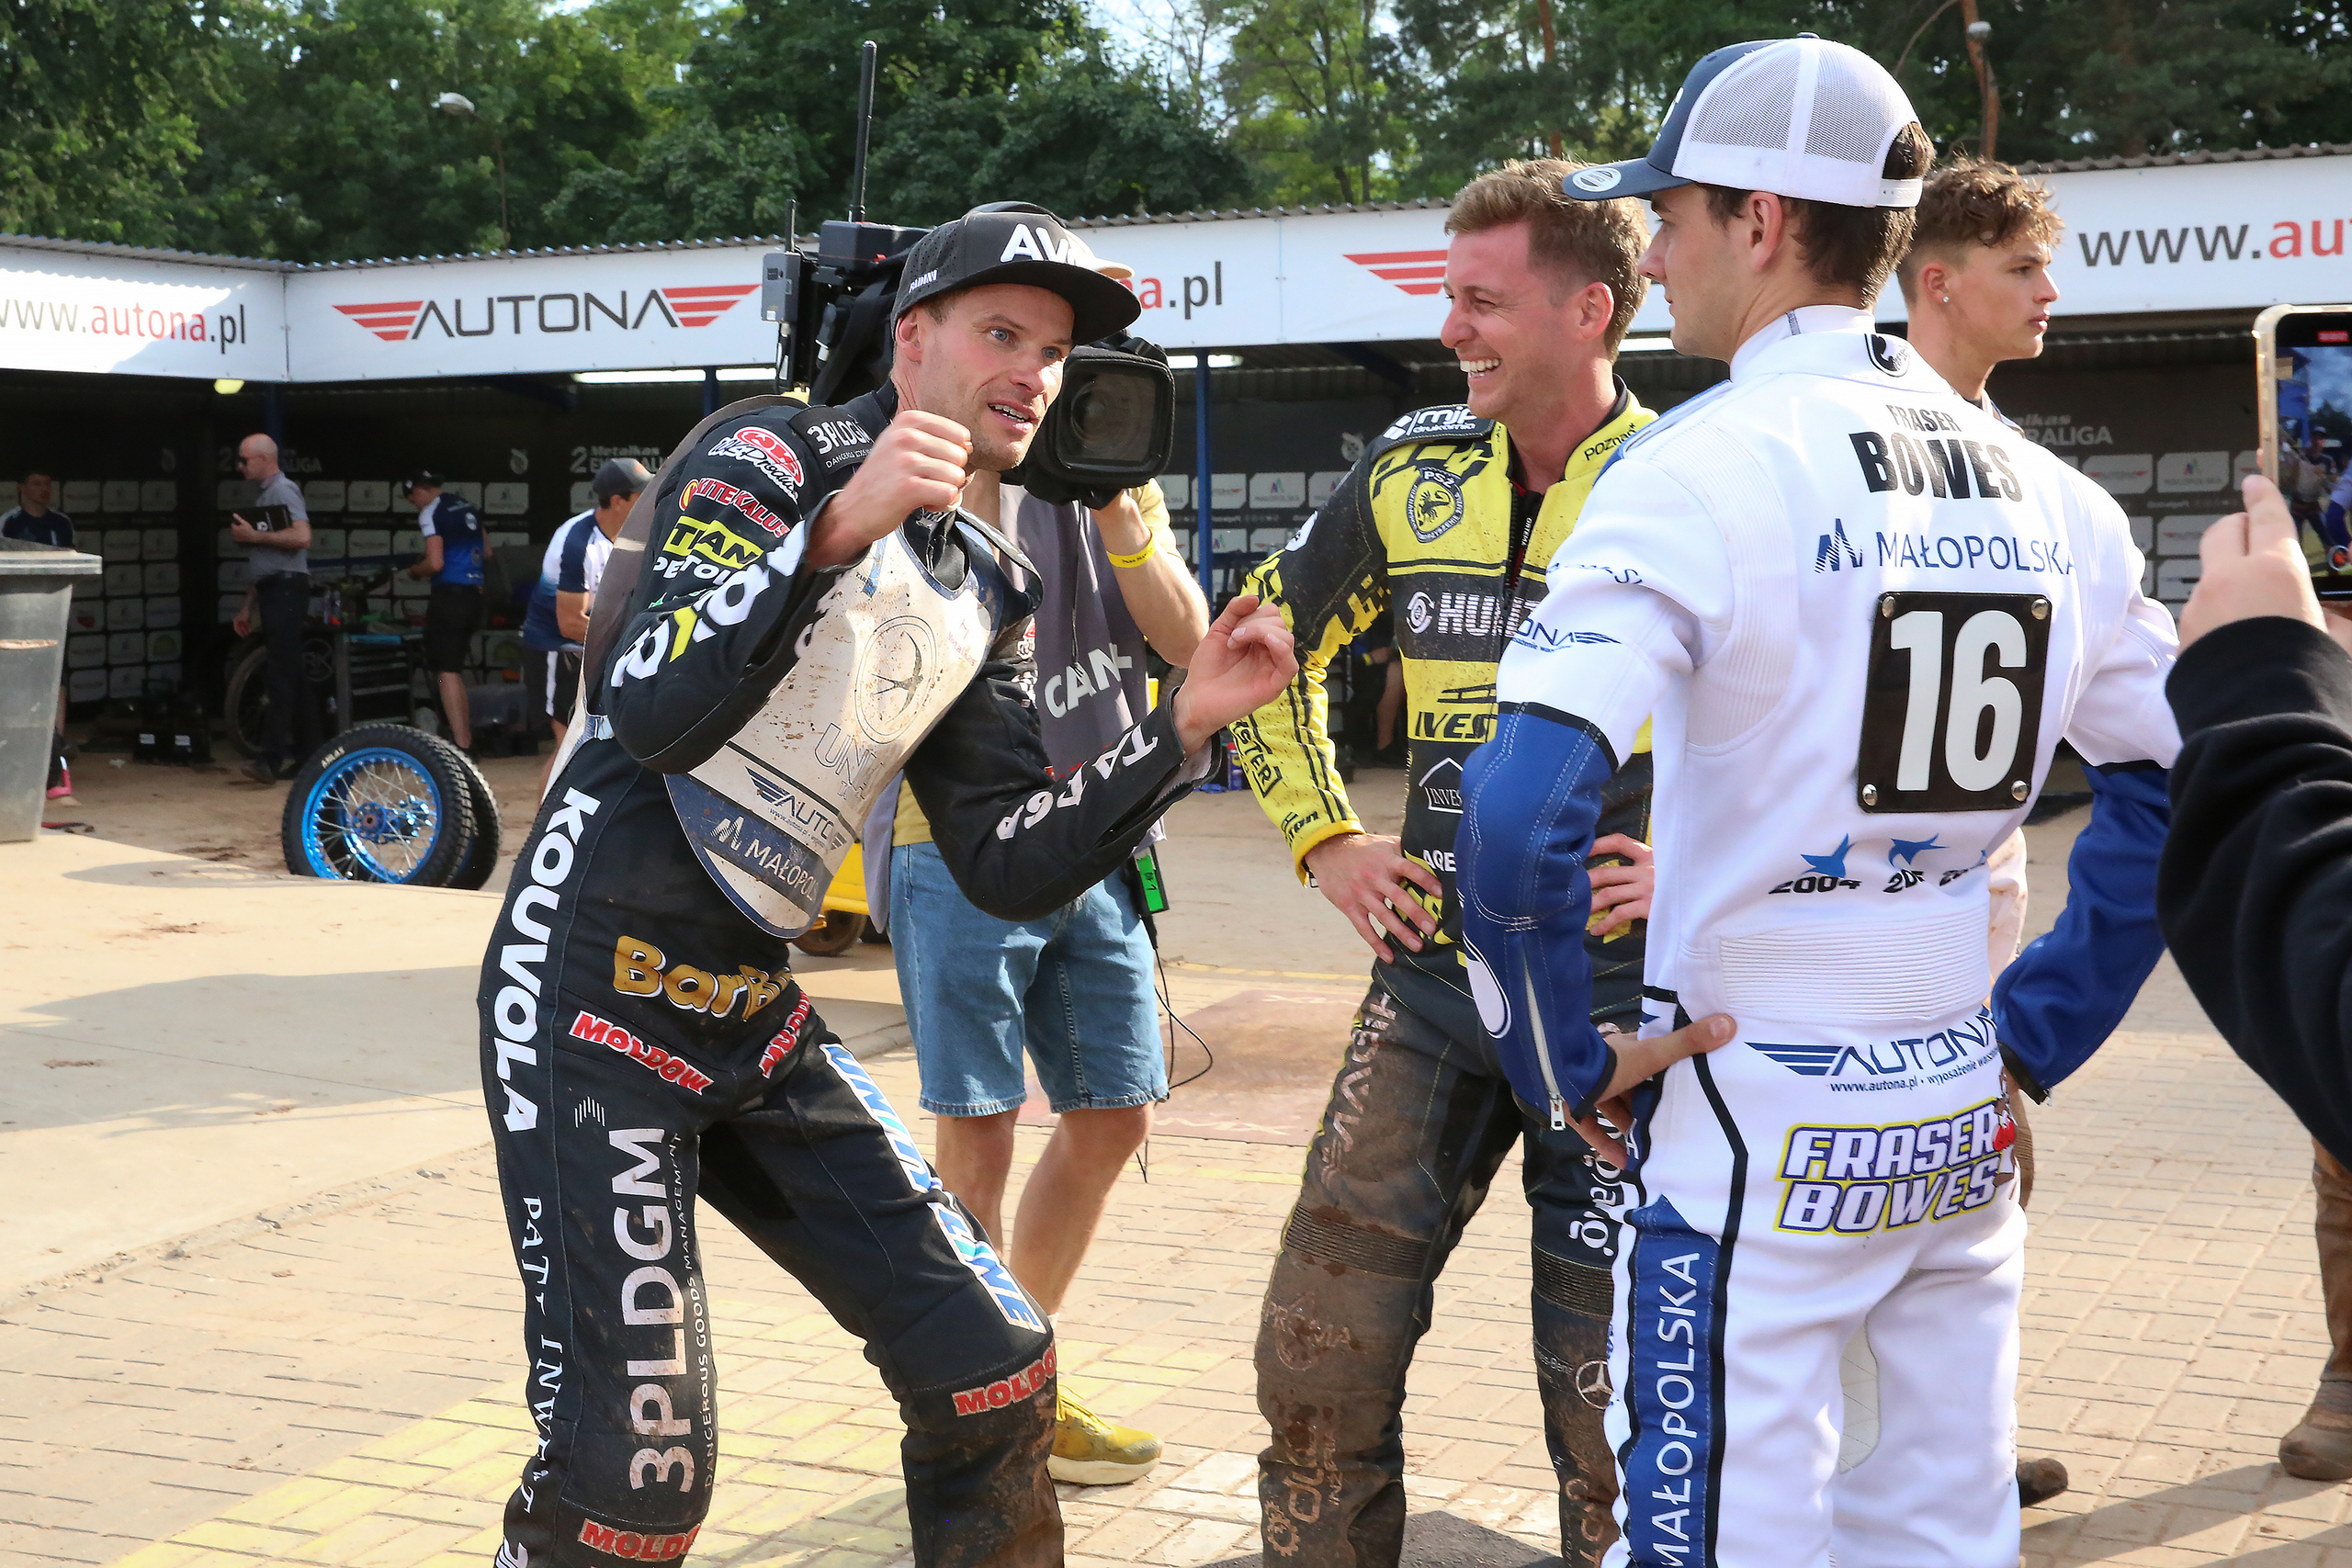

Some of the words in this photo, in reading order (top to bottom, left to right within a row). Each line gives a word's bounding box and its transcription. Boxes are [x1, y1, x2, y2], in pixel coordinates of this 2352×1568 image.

[2078, 218, 2352, 267] www.au
[412, 288, 678, 340] AUTONA
[1885, 404, 1962, 432] FRASER
[1848, 431, 2023, 502] BOWES
[1889, 609, 2028, 793] 16
[492, 786, 602, 1134] KOUVOLA
[568, 1010, 715, 1096] MOLDOW
[1829, 1075, 1918, 1093] www.autona.pl
[1779, 1097, 2000, 1182] FRASER
[1775, 1155, 2003, 1236] BOWES
[607, 1127, 695, 1494] 3PLDGM
[686, 1276, 708, 1348] GOODS
[951, 1340, 1057, 1417] MOLDO
[697, 1352, 715, 1489] DANGEROUS
